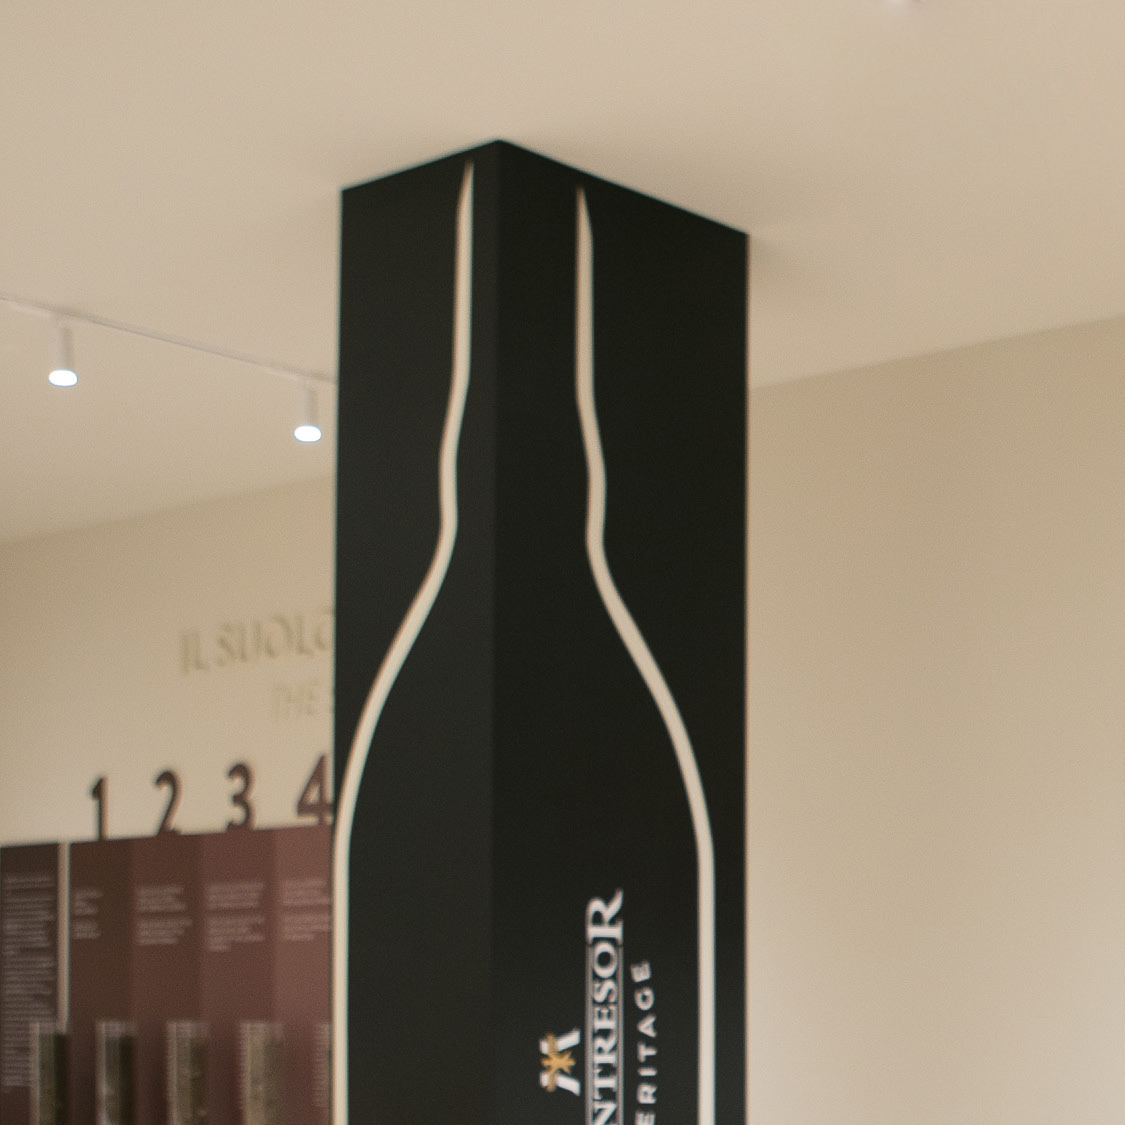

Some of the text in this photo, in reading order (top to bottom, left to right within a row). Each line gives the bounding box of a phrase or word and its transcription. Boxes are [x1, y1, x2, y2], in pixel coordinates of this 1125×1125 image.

[91, 755, 333, 840] 1 2 3 4
